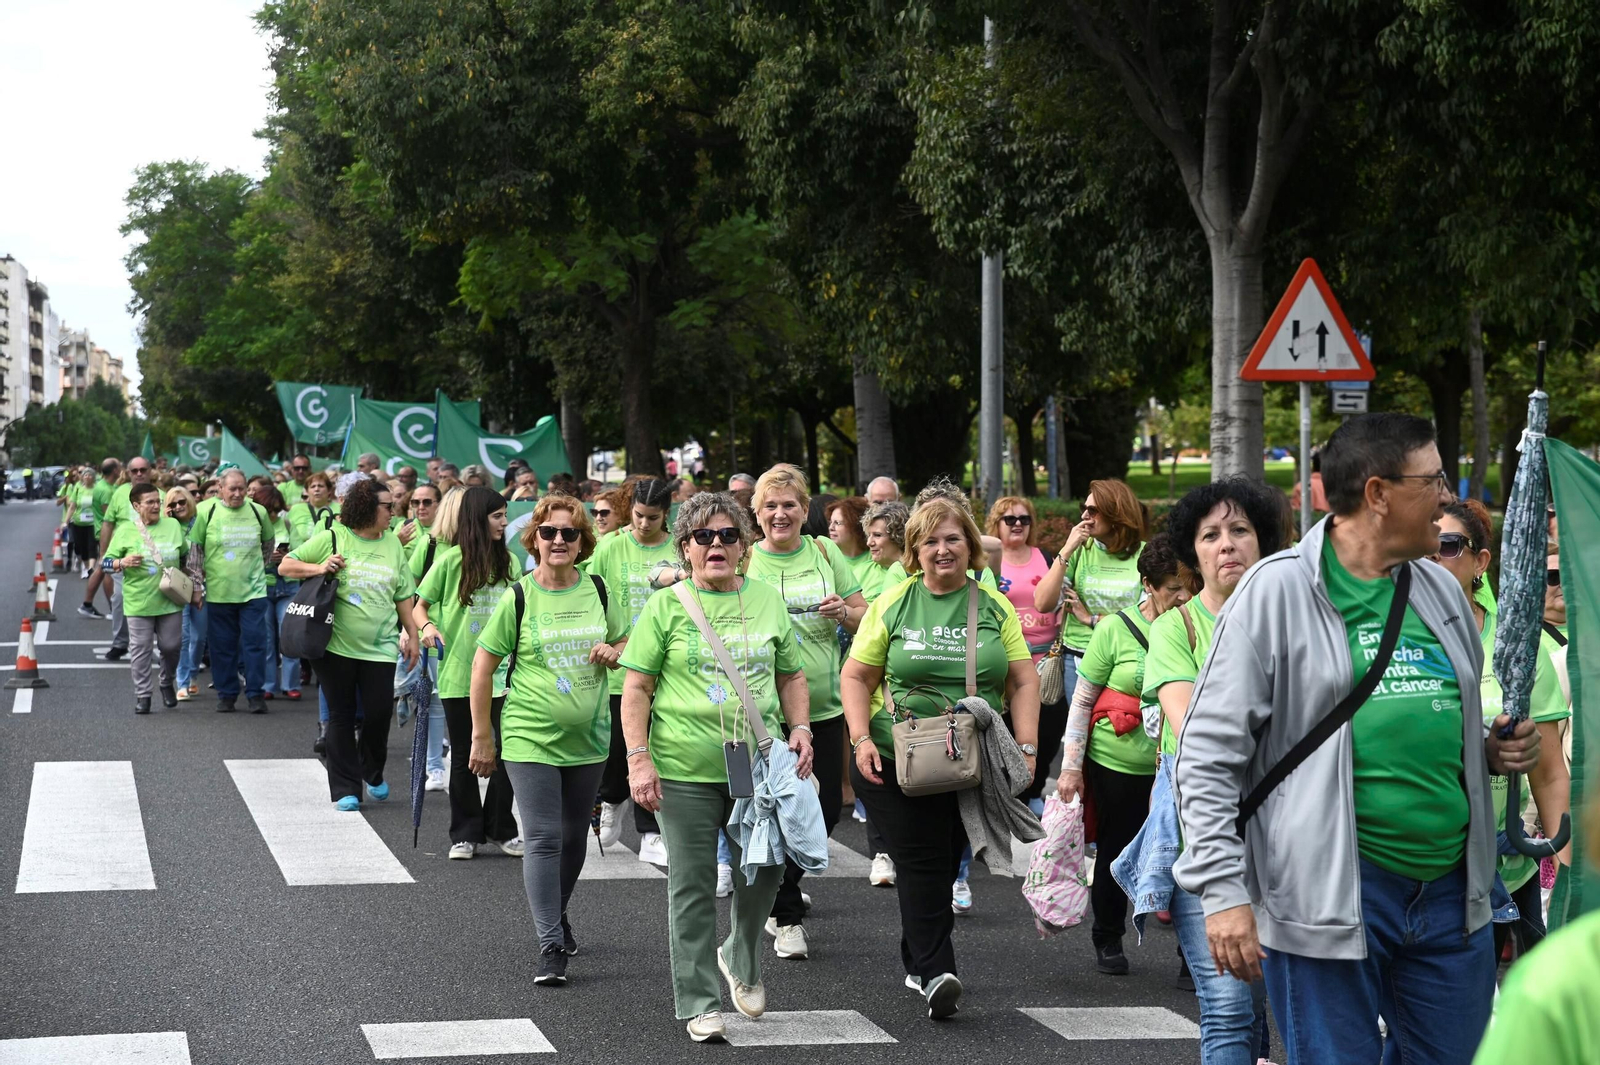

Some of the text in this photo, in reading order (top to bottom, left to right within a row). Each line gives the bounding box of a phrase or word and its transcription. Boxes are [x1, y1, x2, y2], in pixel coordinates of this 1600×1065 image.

[349, 569, 382, 581] contra
[630, 574, 642, 583] En
[1086, 575, 1098, 584] En
[1085, 587, 1123, 597] contra
[784, 594, 820, 606] ontra
[470, 602, 496, 614] cánc
[541, 625, 604, 639] En marcha
[1358, 631, 1380, 645] En
[544, 639, 591, 653] contra
[757, 644, 770, 657] el
[947, 641, 984, 652] mara
[547, 652, 589, 669] cánc
[1363, 646, 1424, 662] mcha
[1366, 663, 1421, 678] ntra
[1390, 677, 1444, 693] cáncer
